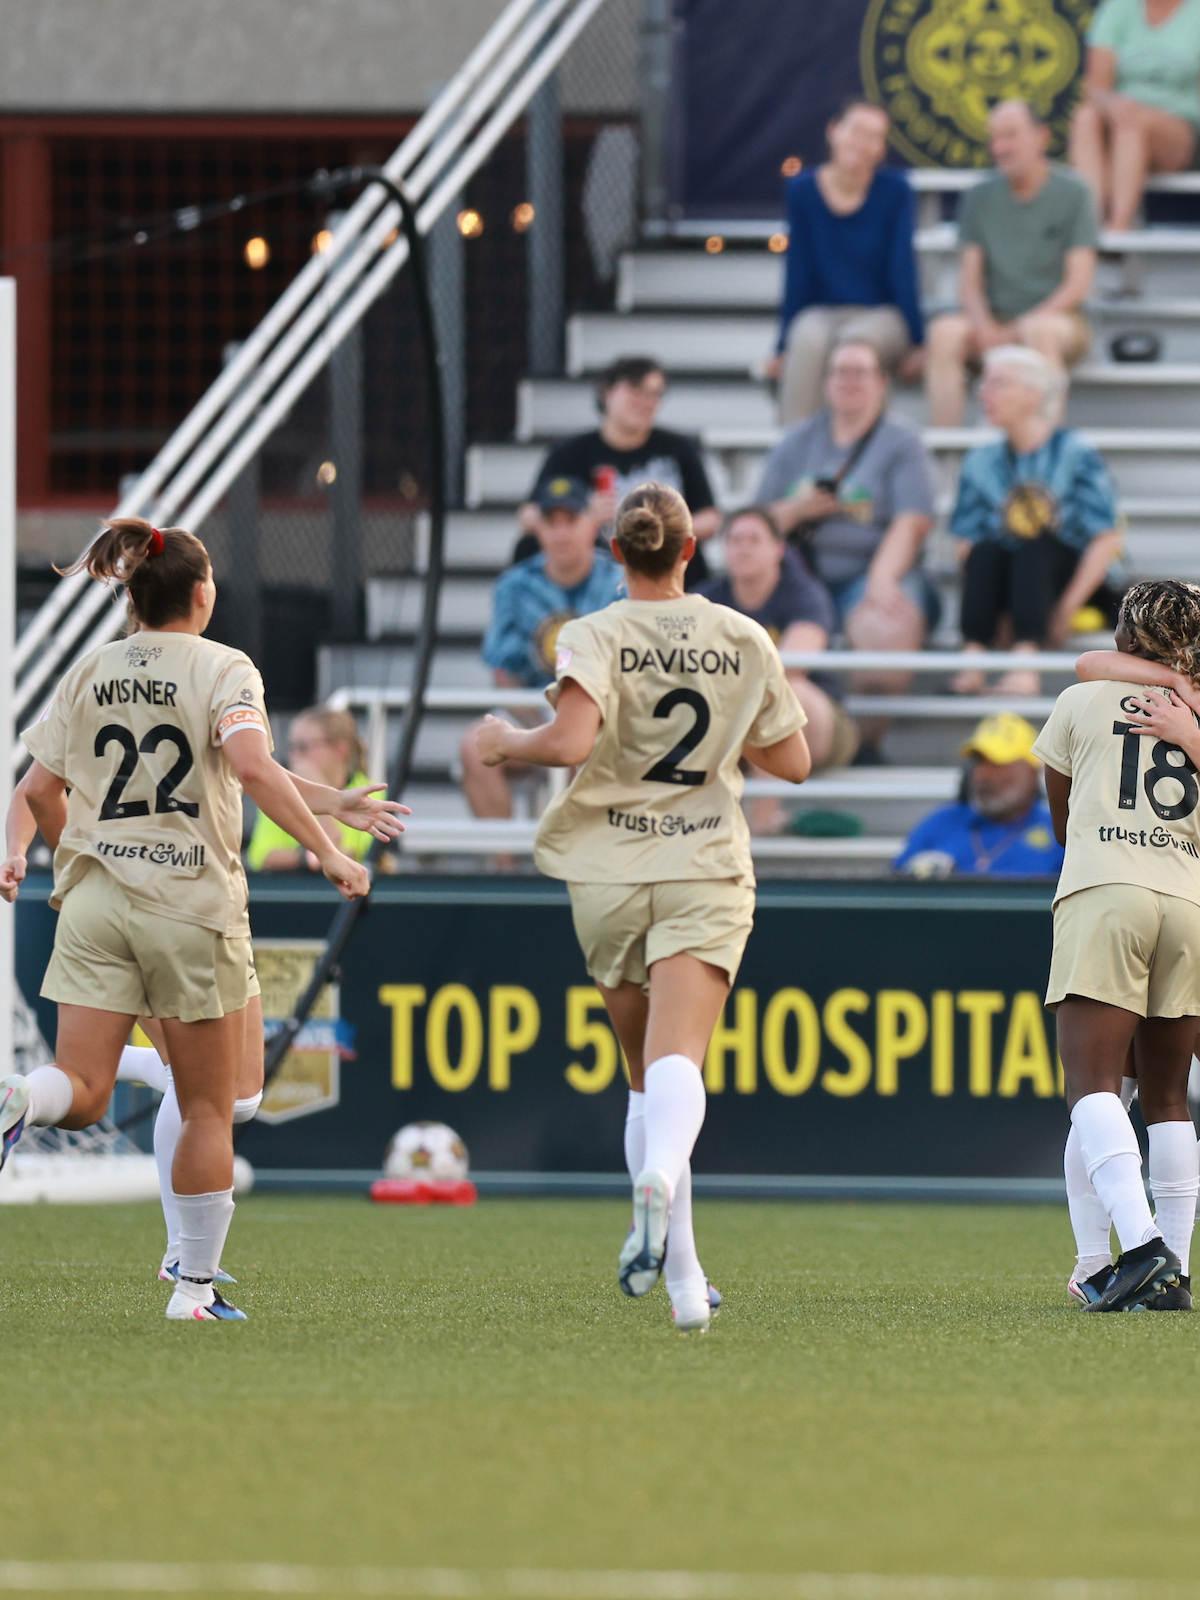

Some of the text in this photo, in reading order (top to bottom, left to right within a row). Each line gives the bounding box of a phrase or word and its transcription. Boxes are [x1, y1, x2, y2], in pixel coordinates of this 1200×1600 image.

[124, 652, 162, 661] TRINITY
[127, 645, 163, 654] DALLAS
[620, 648, 741, 676] DAVISON
[93, 678, 178, 707] WISNER
[641, 687, 710, 786] 2
[94, 723, 200, 822] 22
[1112, 719, 1199, 821] 18
[378, 983, 541, 1092] TOP
[565, 985, 631, 1095] 5
[703, 986, 1064, 1098] HOSPITA
